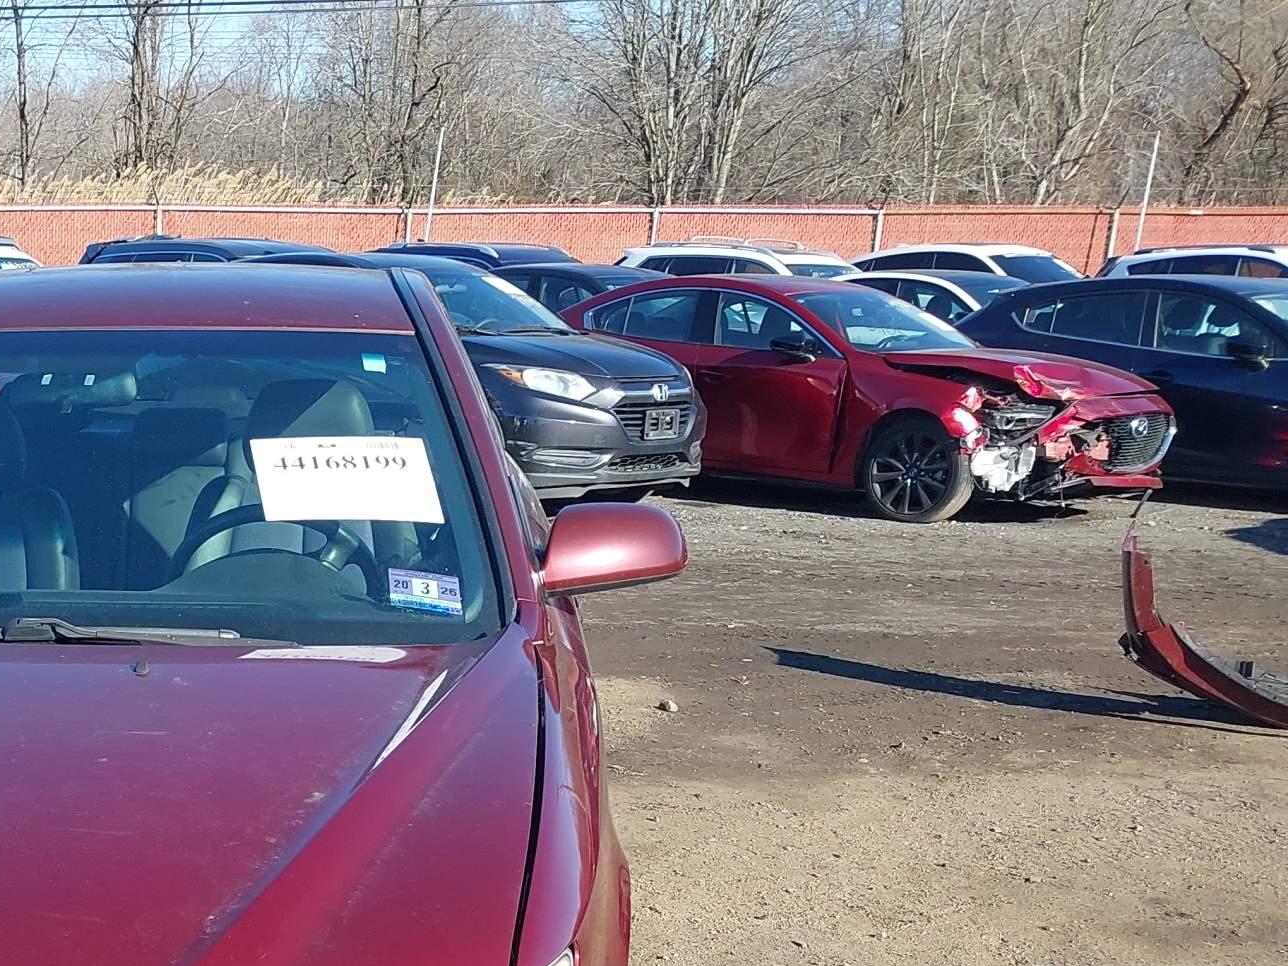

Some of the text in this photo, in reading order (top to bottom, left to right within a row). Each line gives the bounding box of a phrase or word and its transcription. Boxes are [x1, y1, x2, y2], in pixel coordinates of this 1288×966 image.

[273, 455, 408, 471] 44168199
[393, 579, 458, 597] 20 3 26
